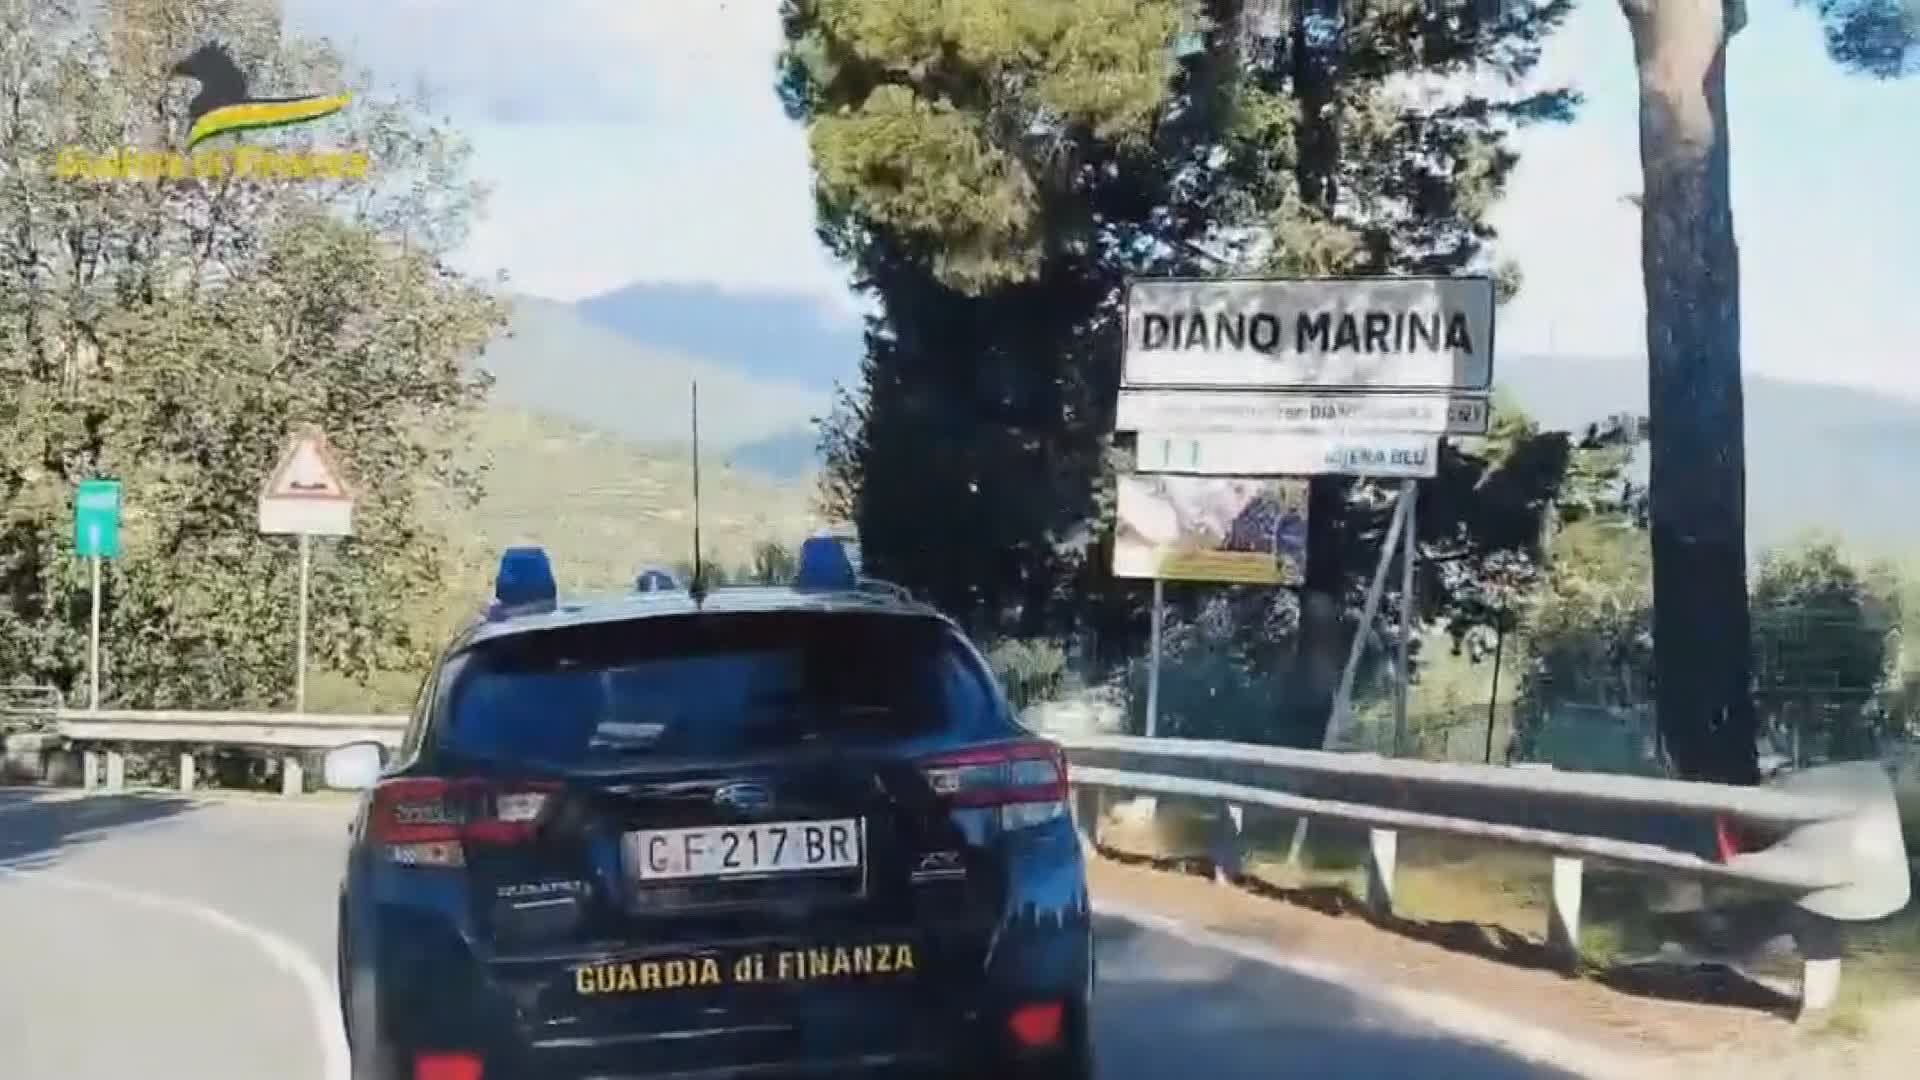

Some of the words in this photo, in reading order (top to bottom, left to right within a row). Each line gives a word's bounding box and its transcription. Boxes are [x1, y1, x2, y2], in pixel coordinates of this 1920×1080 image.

[1142, 312, 1280, 355] DIANO
[1296, 311, 1474, 355] MARINA
[721, 827, 789, 868] 217
[805, 825, 849, 864] BR
[575, 958, 721, 993] GUARDIA
[734, 954, 764, 983] di
[778, 944, 914, 980] FINANZA
